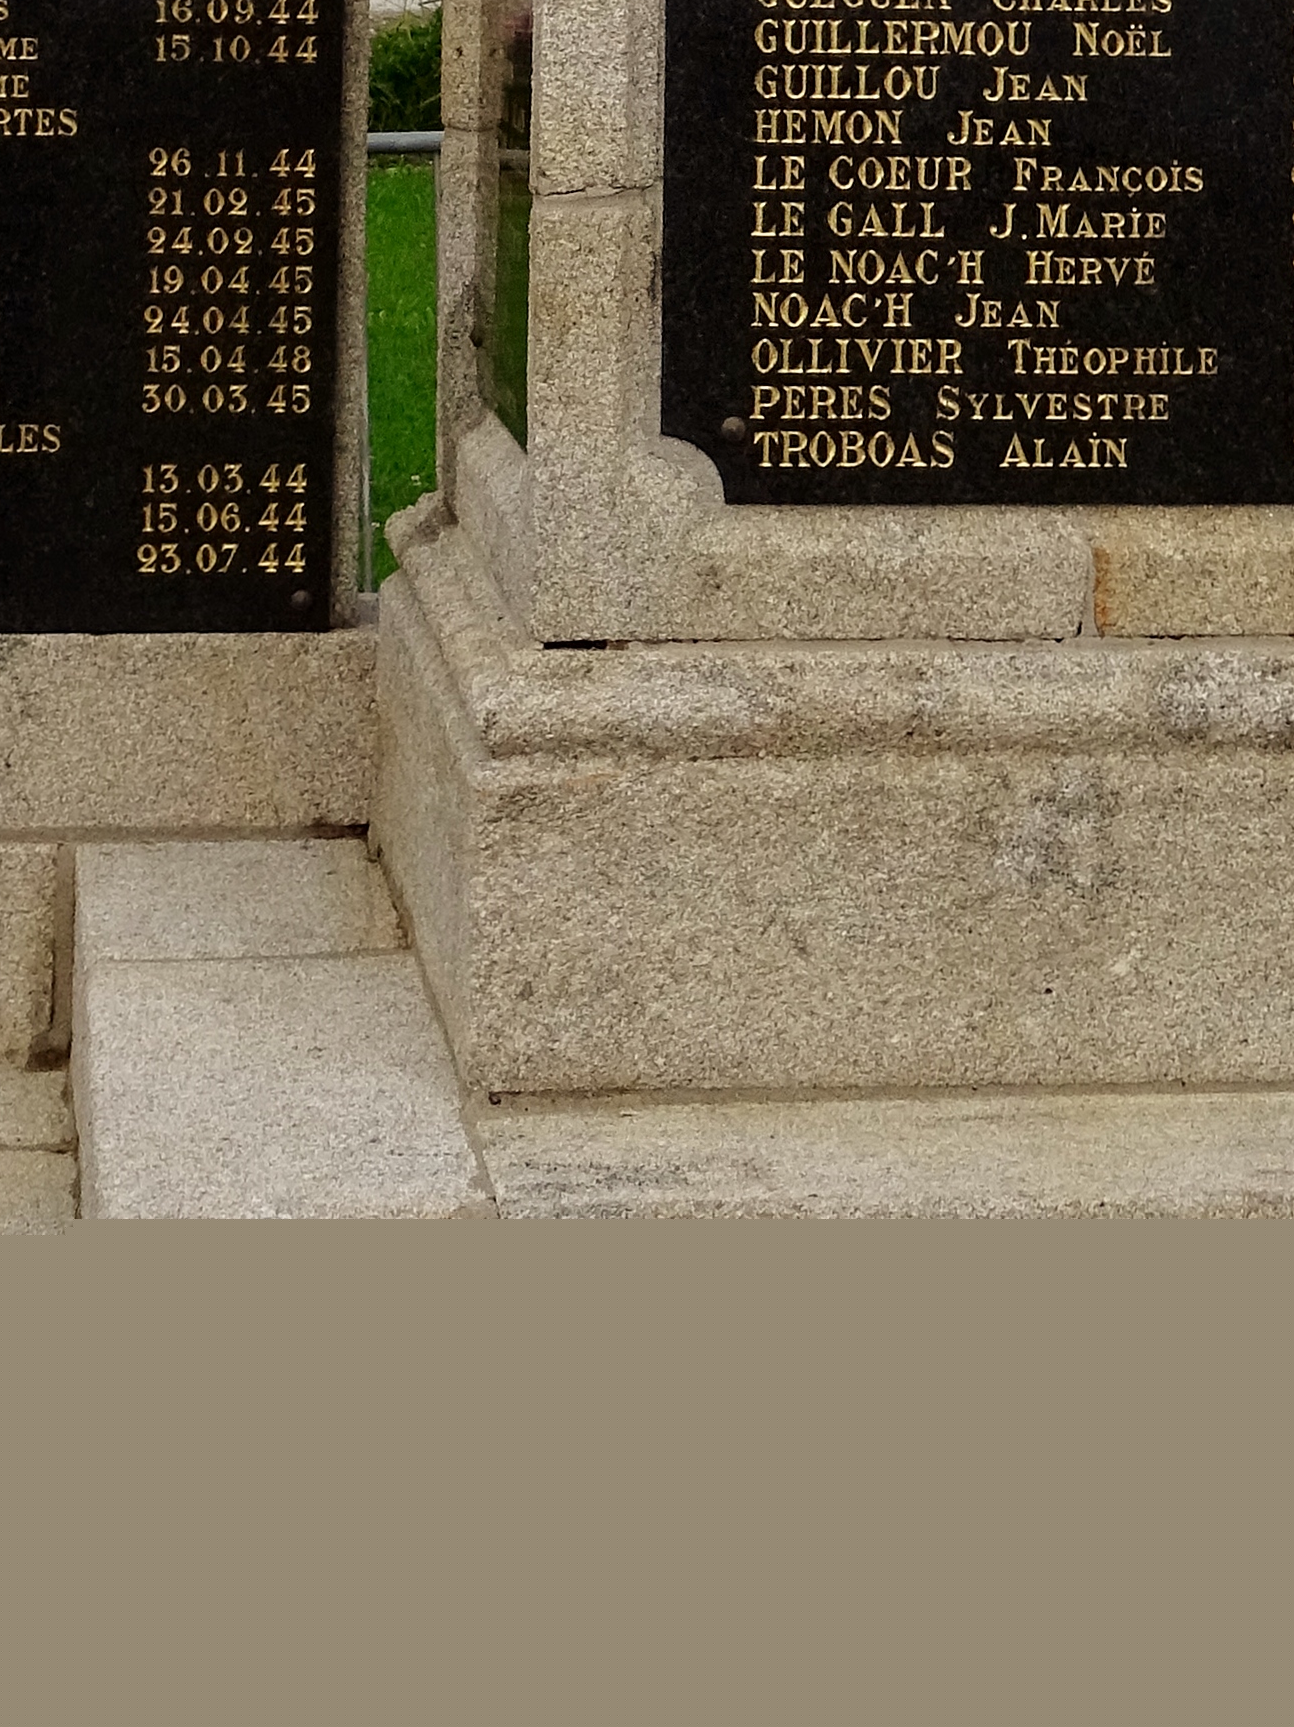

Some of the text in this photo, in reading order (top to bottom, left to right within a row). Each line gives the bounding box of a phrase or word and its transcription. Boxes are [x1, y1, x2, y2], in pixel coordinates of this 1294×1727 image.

[755, 18, 1031, 57] GUILLERMOU
[755, 64, 940, 100] GUILLOU
[755, 109, 903, 144] HEMON
[753, 155, 805, 190] LE
[829, 155, 971, 191] COEUR
[751, 202, 804, 237] LE
[828, 201, 944, 238] GALL
[751, 249, 804, 283] LE
[752, 338, 963, 374] OLLIVIER
[750, 385, 891, 420] PERES
[754, 430, 954, 468] TROBOAS
